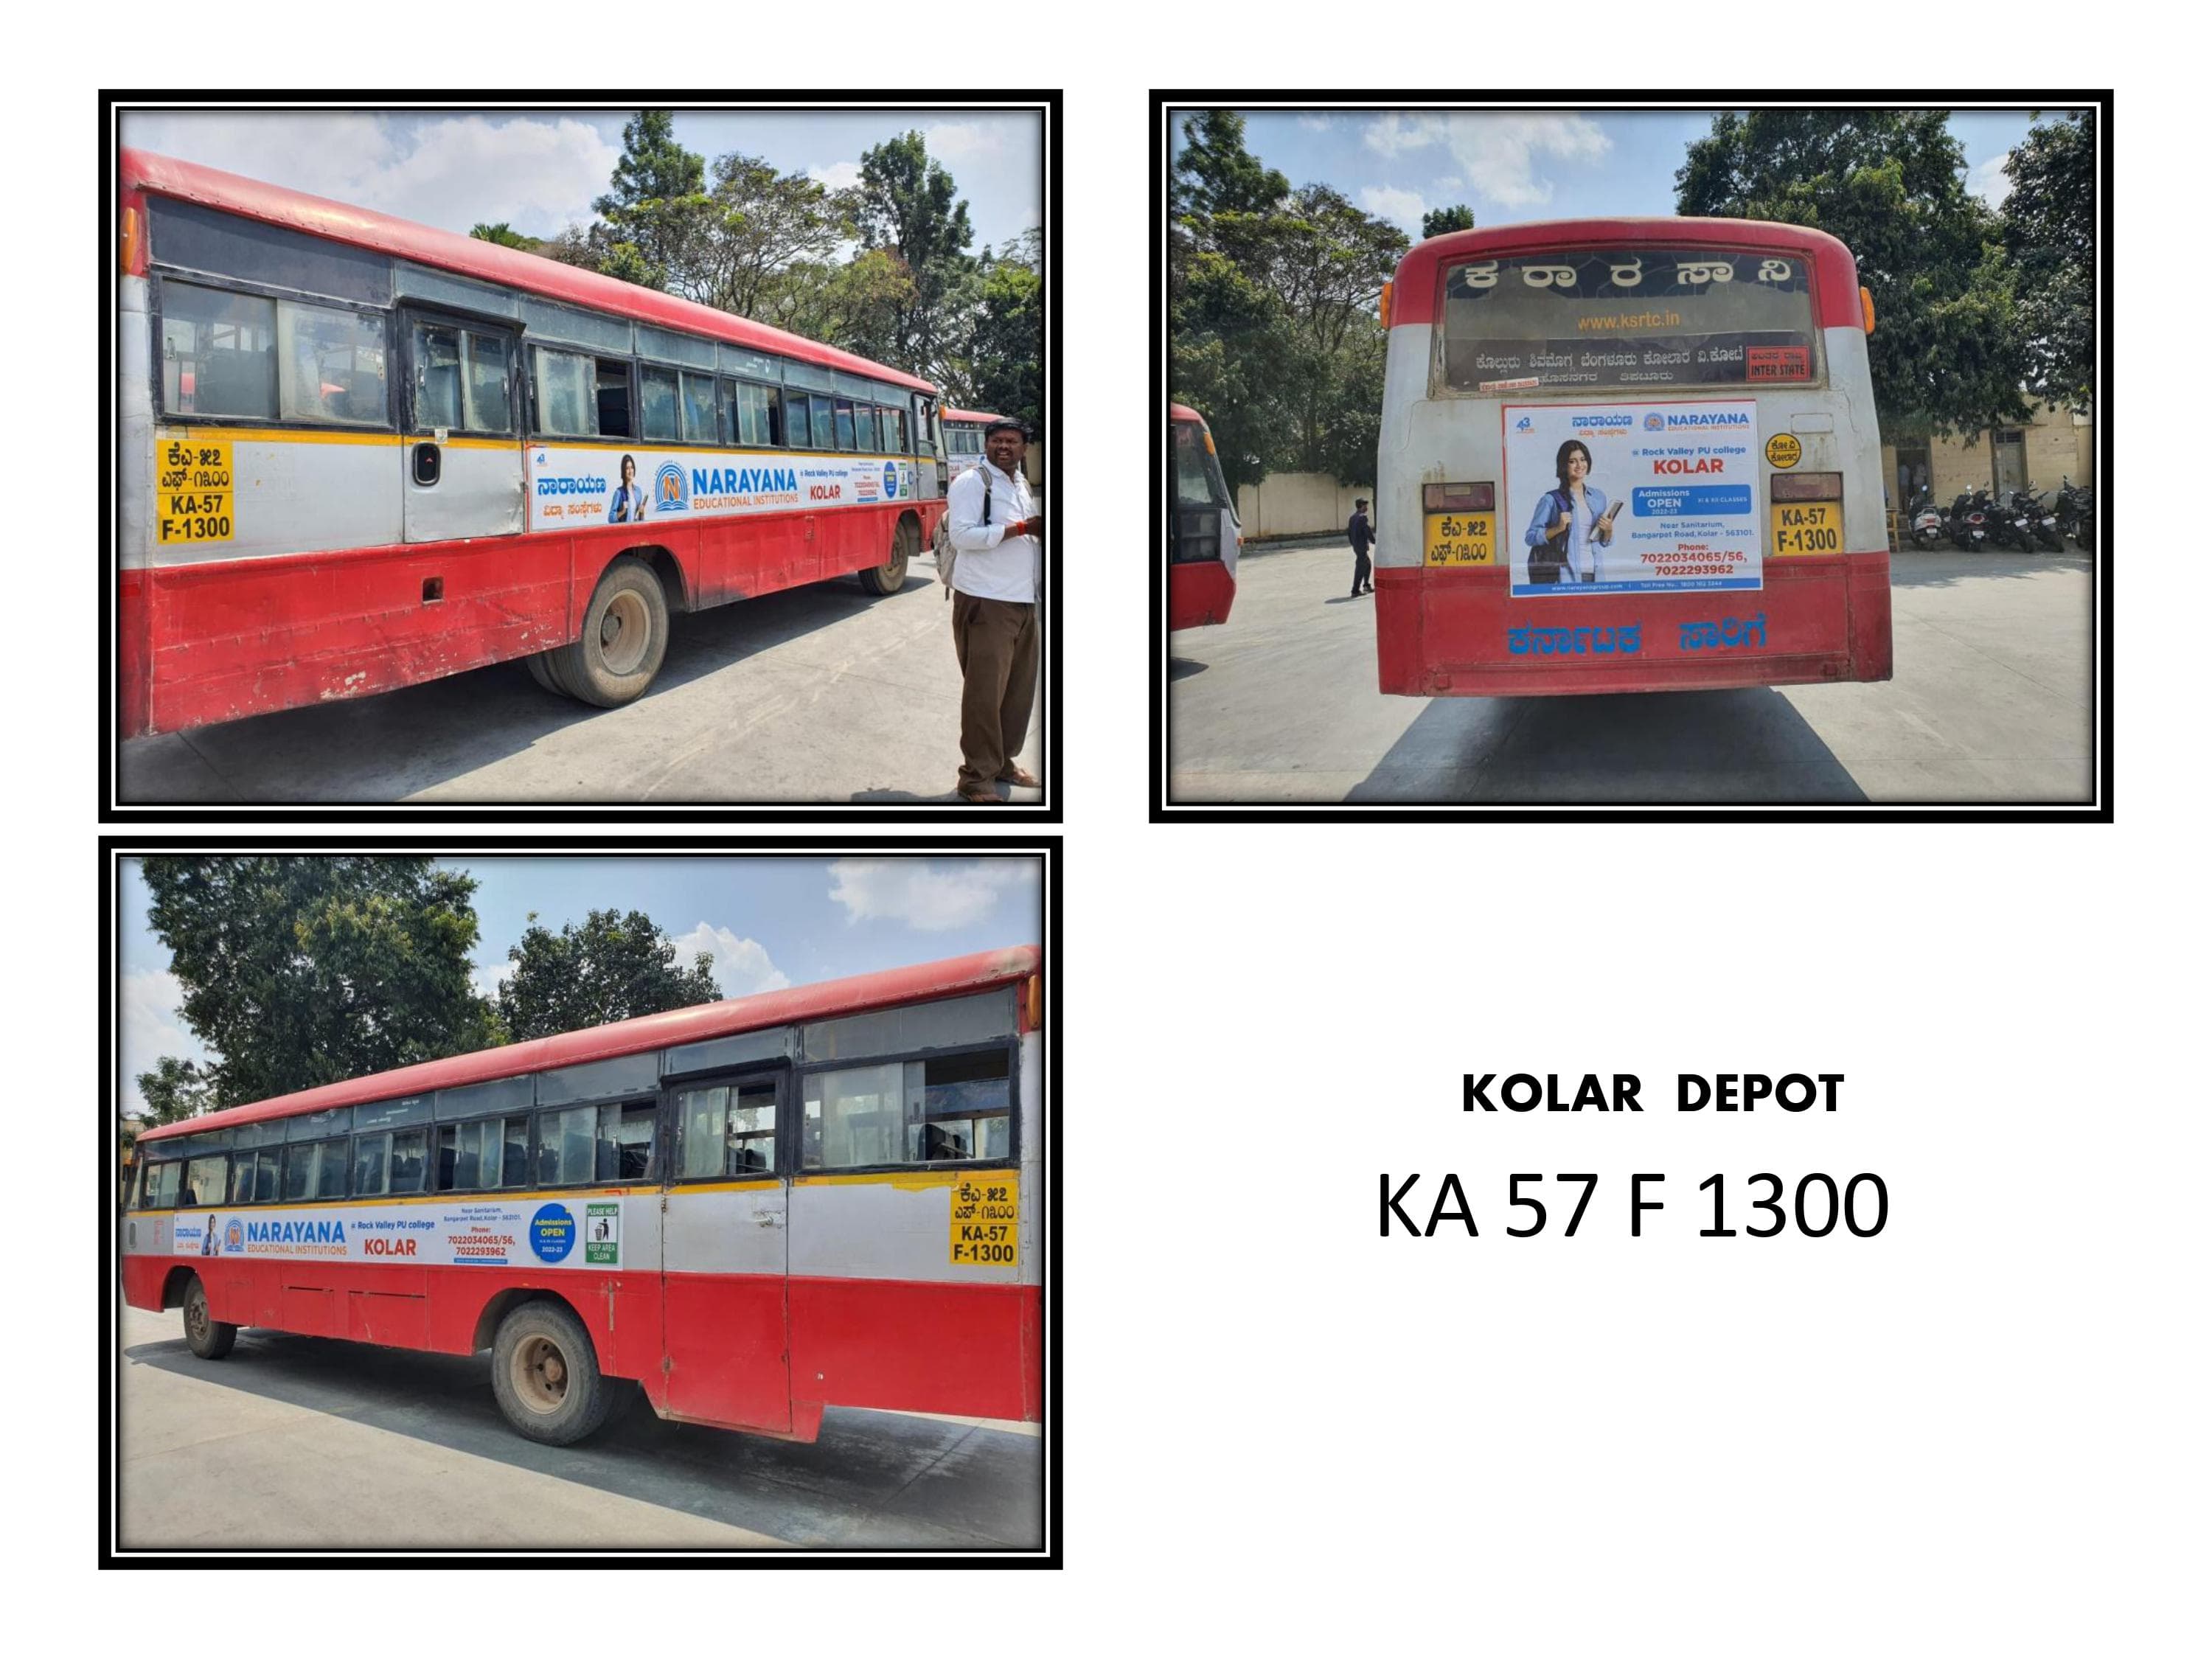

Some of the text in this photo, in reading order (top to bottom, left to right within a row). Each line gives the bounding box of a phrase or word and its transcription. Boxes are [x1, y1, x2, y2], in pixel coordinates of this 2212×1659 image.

[1578, 310, 1680, 331] www.ksrtc.in
[1751, 364, 1806, 377] INTER STATE
[1572, 411, 1632, 428] ನಾರಾಯಣ
[1668, 413, 1750, 425] NARAYANA
[1642, 448, 1665, 456] Rock
[1667, 447, 1694, 456] Valley
[1698, 446, 1711, 454] PU
[1713, 445, 1747, 455] college
[1654, 459, 1724, 475] KOLAR
[538, 474, 606, 495] ನಾರಾಯಣ
[692, 468, 798, 495] NARAYANA
[810, 485, 841, 500] KOLAR
[1638, 490, 1690, 498] Admissions
[171, 495, 223, 515] KA-57
[694, 493, 799, 509] EDUCATIONAL INSTITUTIONS
[1647, 498, 1682, 508] OPEN
[1782, 507, 1826, 526] KA-57
[162, 517, 230, 540] F-1300
[1778, 528, 1837, 552] F-1300
[1641, 551, 1748, 564] 7022034065/56,
[1655, 565, 1733, 576] 7022293962
[605, 1207, 617, 1216] HELP
[358, 1221, 373, 1229] Rock
[375, 1220, 395, 1231] Valley
[397, 1220, 407, 1228] PU
[408, 1220, 435, 1230] college
[535, 1219, 572, 1227] Admissions
[247, 1220, 346, 1243] NARAYANA
[540, 1228, 566, 1237] OPEN
[961, 1225, 1009, 1242] KA-57
[364, 1239, 417, 1255] KOLAR
[448, 1235, 516, 1247] 7022034065/56,
[247, 1244, 347, 1256] EDUCATIONAL INSTITUTIONS
[456, 1247, 507, 1256] 7022293962
[593, 1253, 611, 1261] CLEAN
[953, 1244, 1015, 1262] F-1300
